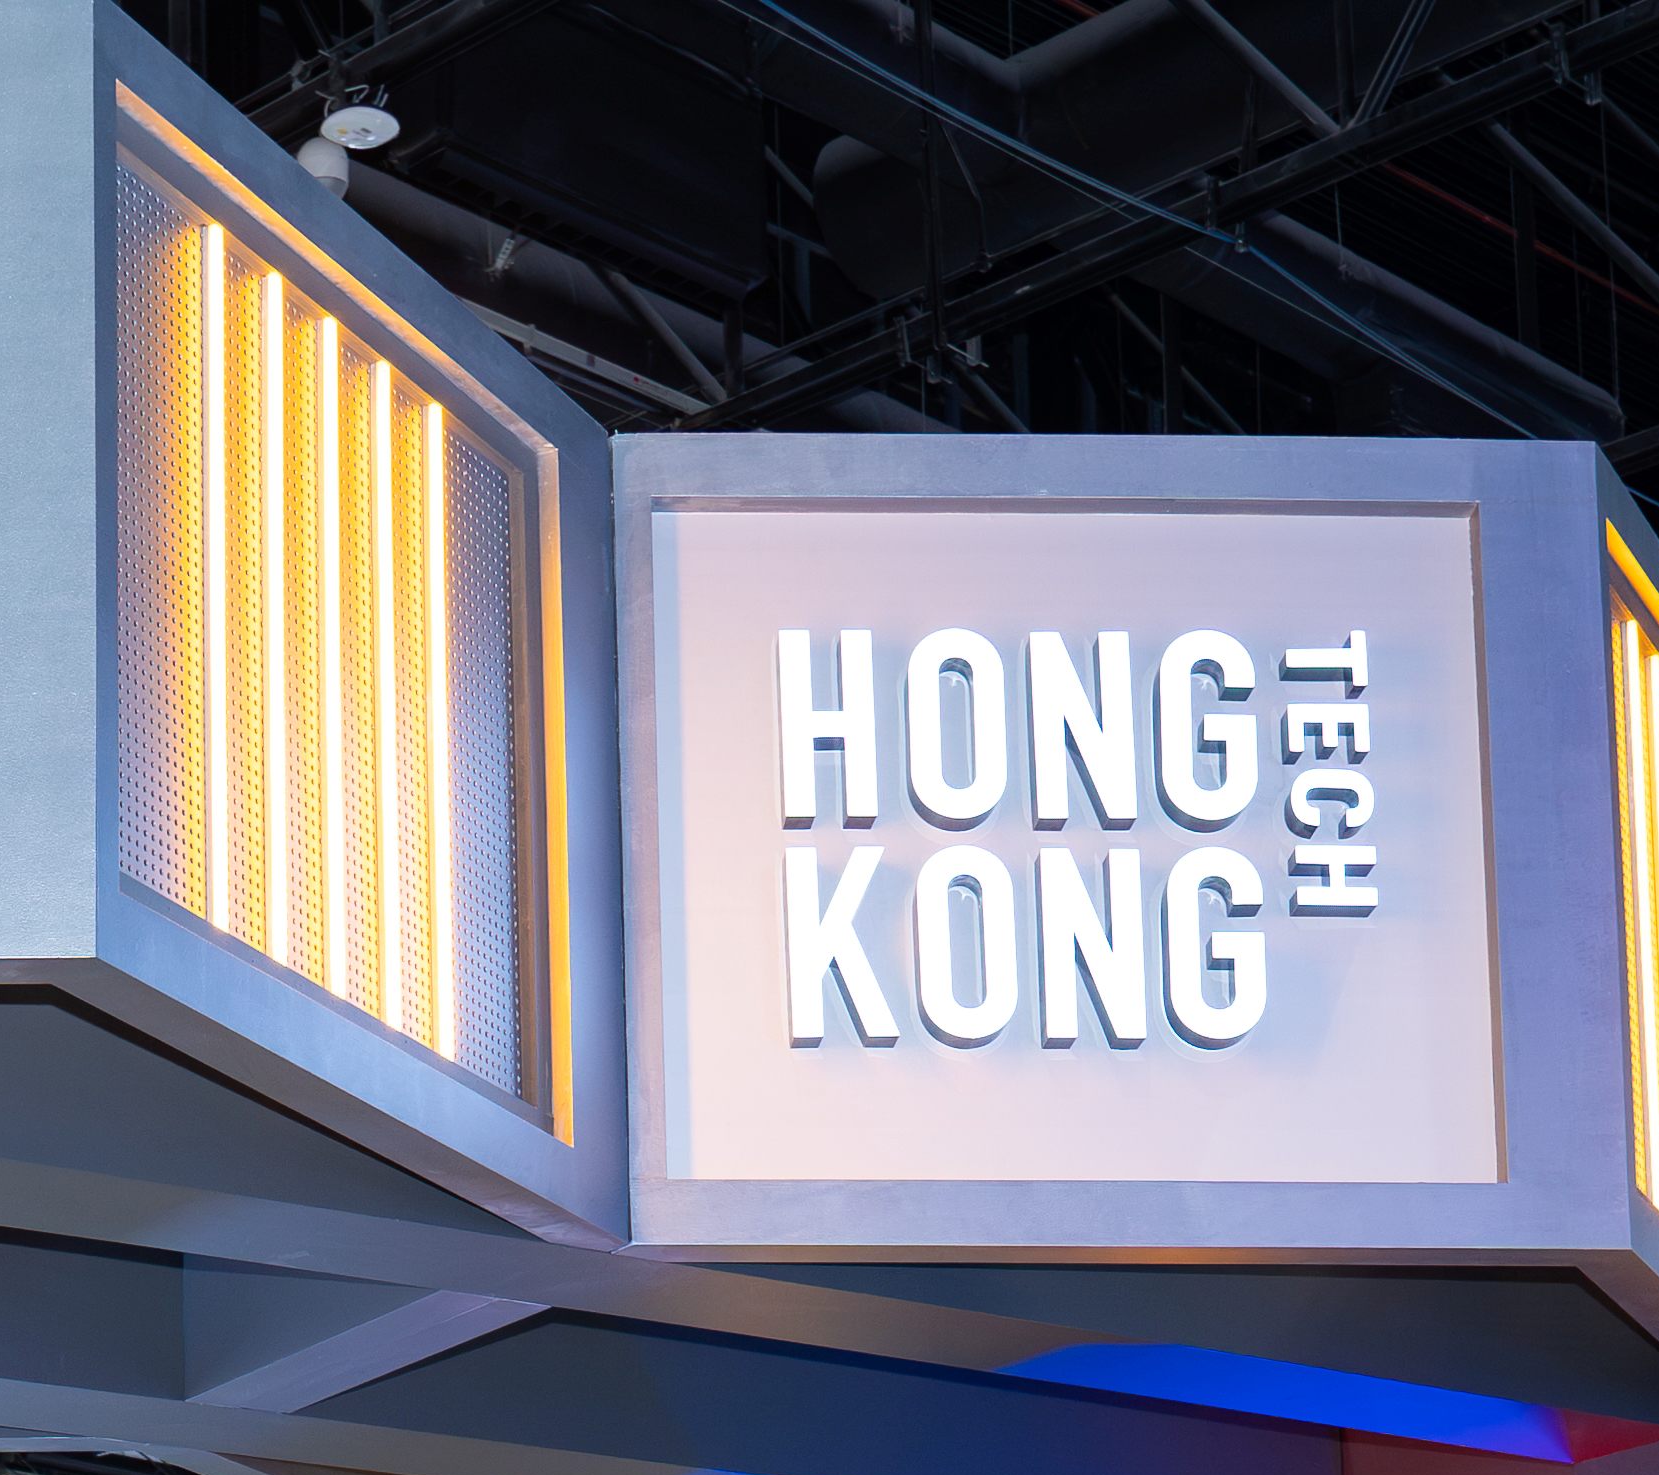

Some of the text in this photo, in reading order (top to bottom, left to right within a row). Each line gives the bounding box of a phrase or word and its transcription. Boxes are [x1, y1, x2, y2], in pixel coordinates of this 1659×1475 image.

[776, 627, 1260, 833] HONG
[1280, 629, 1380, 918] TECH
[784, 844, 1268, 1052] KONG
